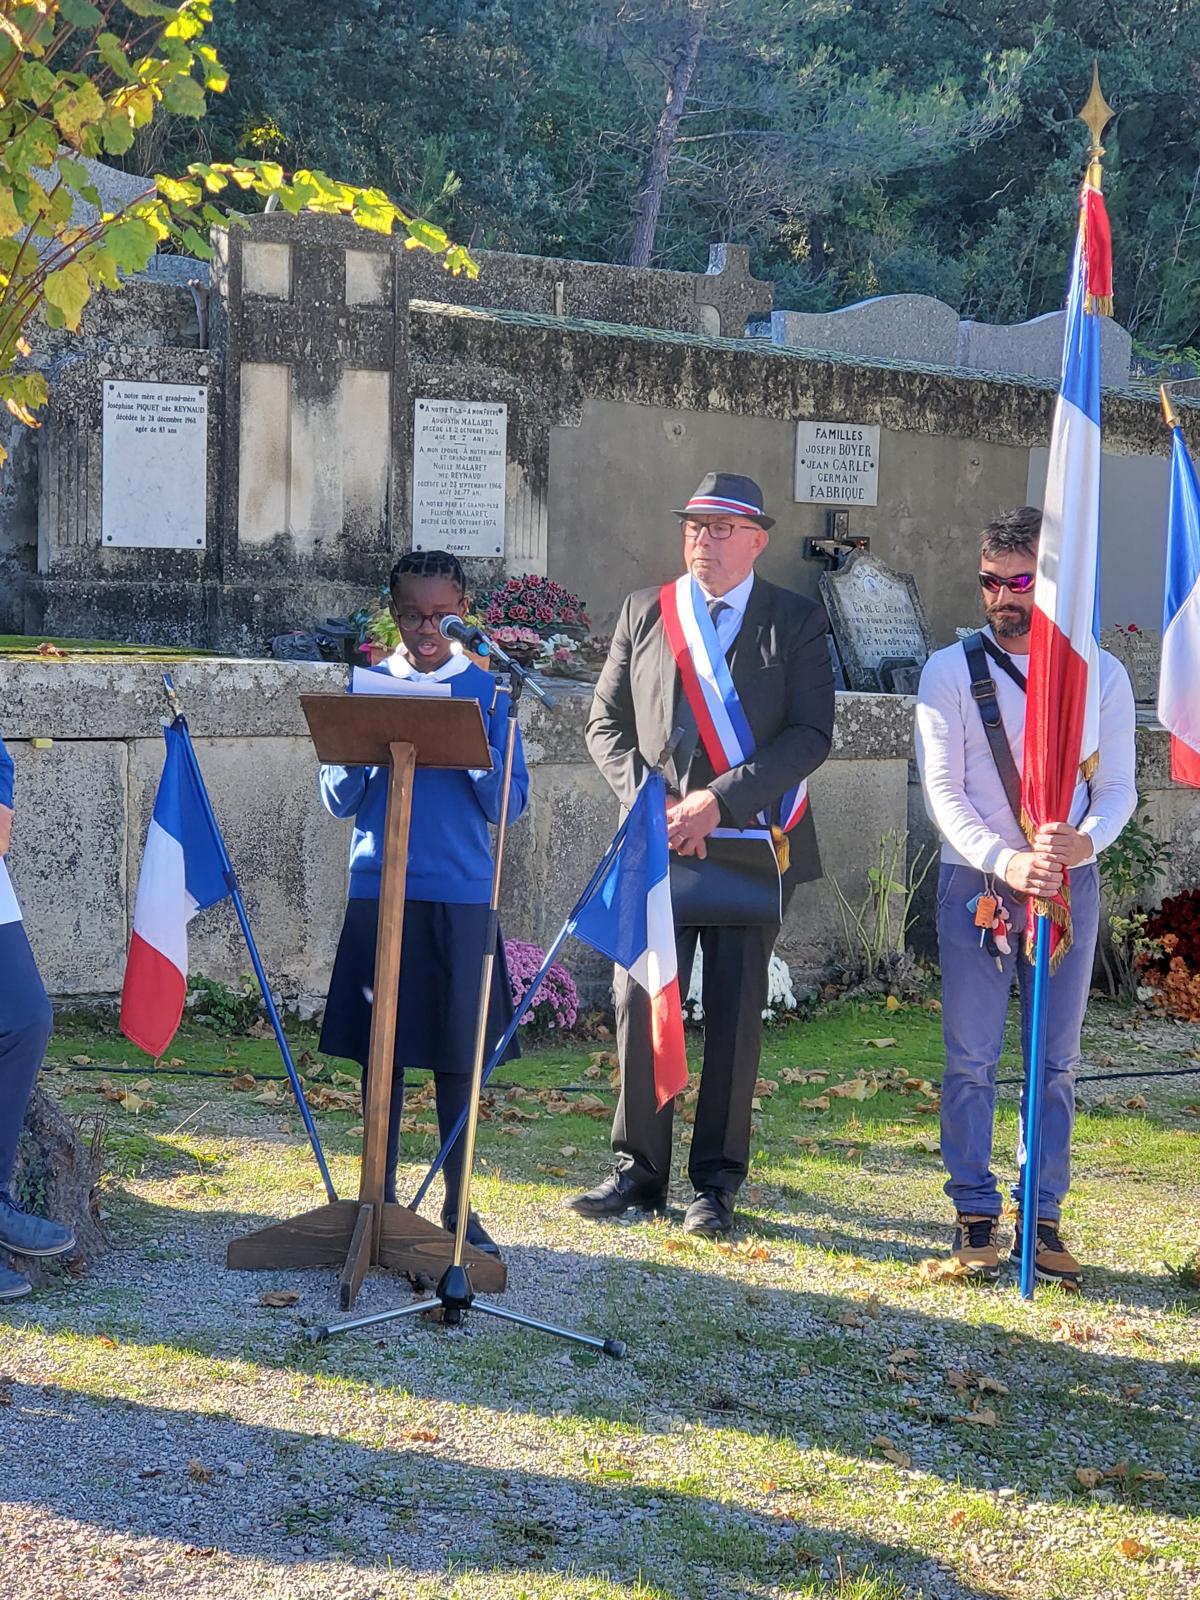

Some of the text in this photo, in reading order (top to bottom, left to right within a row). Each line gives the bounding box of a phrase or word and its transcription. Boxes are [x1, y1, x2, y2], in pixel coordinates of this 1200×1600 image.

[462, 419, 492, 427] MALARET
[816, 428, 862, 440] FAMILLES
[806, 444, 871, 457] JOSEPH BOYER
[806, 459, 869, 472] JEAN CARLE
[818, 473, 858, 483] GERMAIN
[810, 485, 864, 501] FABRIQUE
[853, 602, 904, 614] CARLE JEAN
